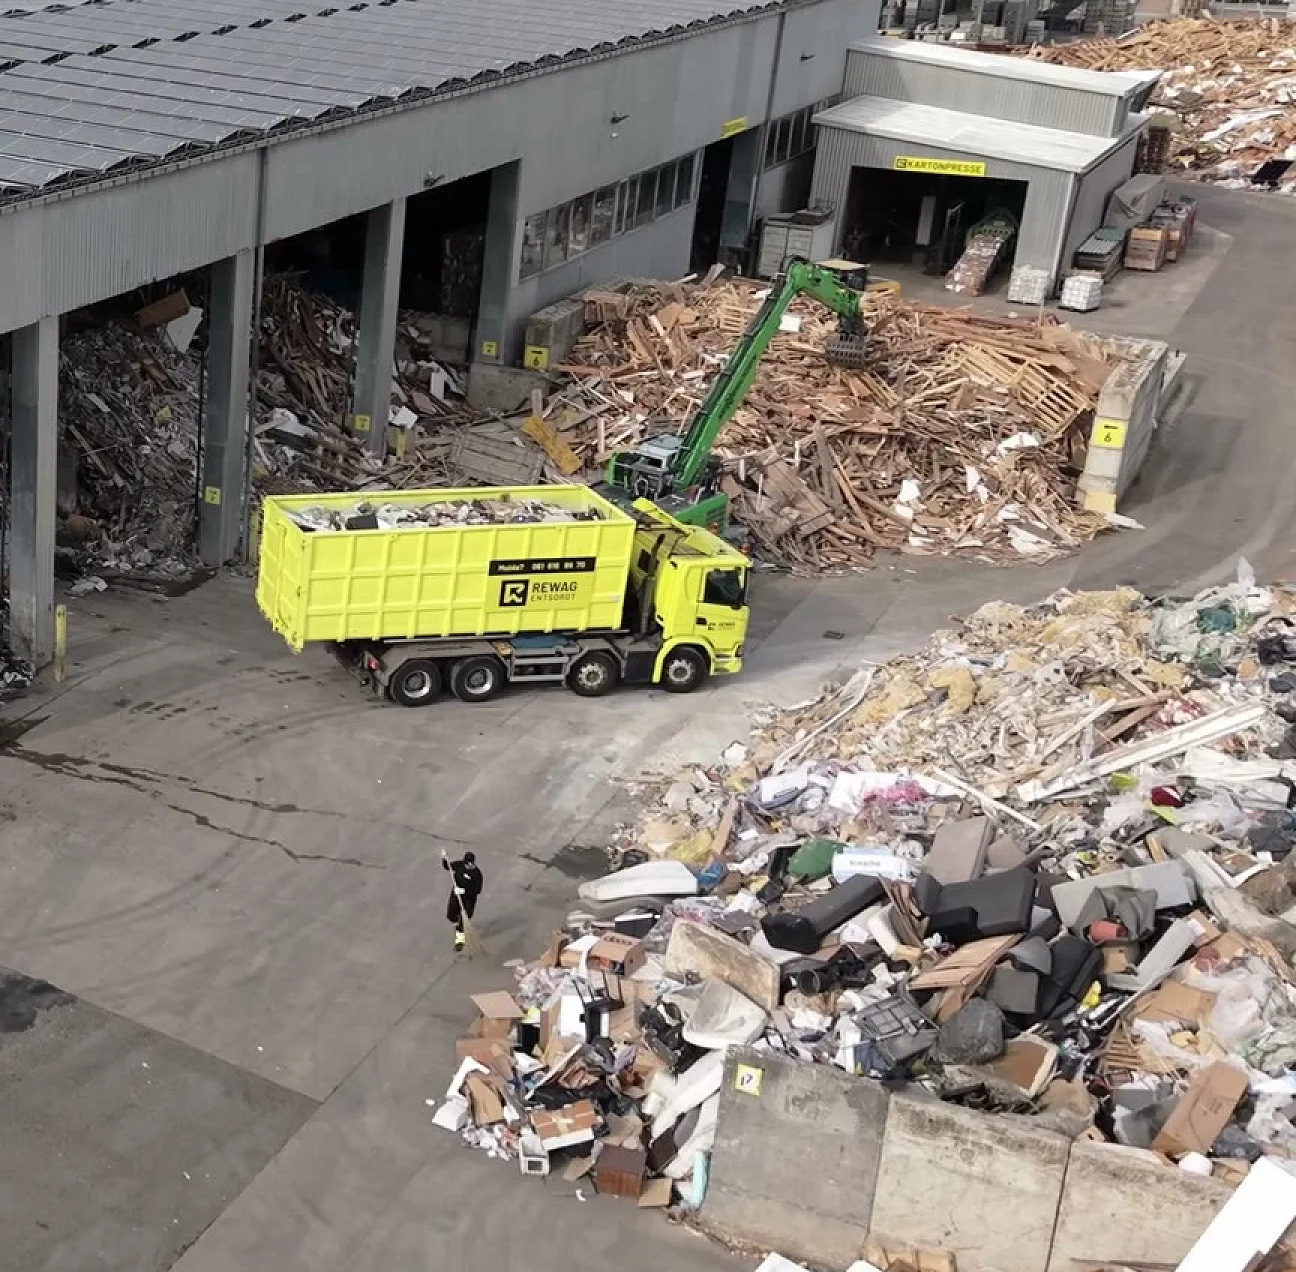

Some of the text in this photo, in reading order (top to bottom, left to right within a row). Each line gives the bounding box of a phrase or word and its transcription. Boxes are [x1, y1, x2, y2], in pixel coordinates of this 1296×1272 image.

[533, 356, 540, 367] 6
[1103, 431, 1113, 443] 6
[533, 582, 577, 593] REWAG
